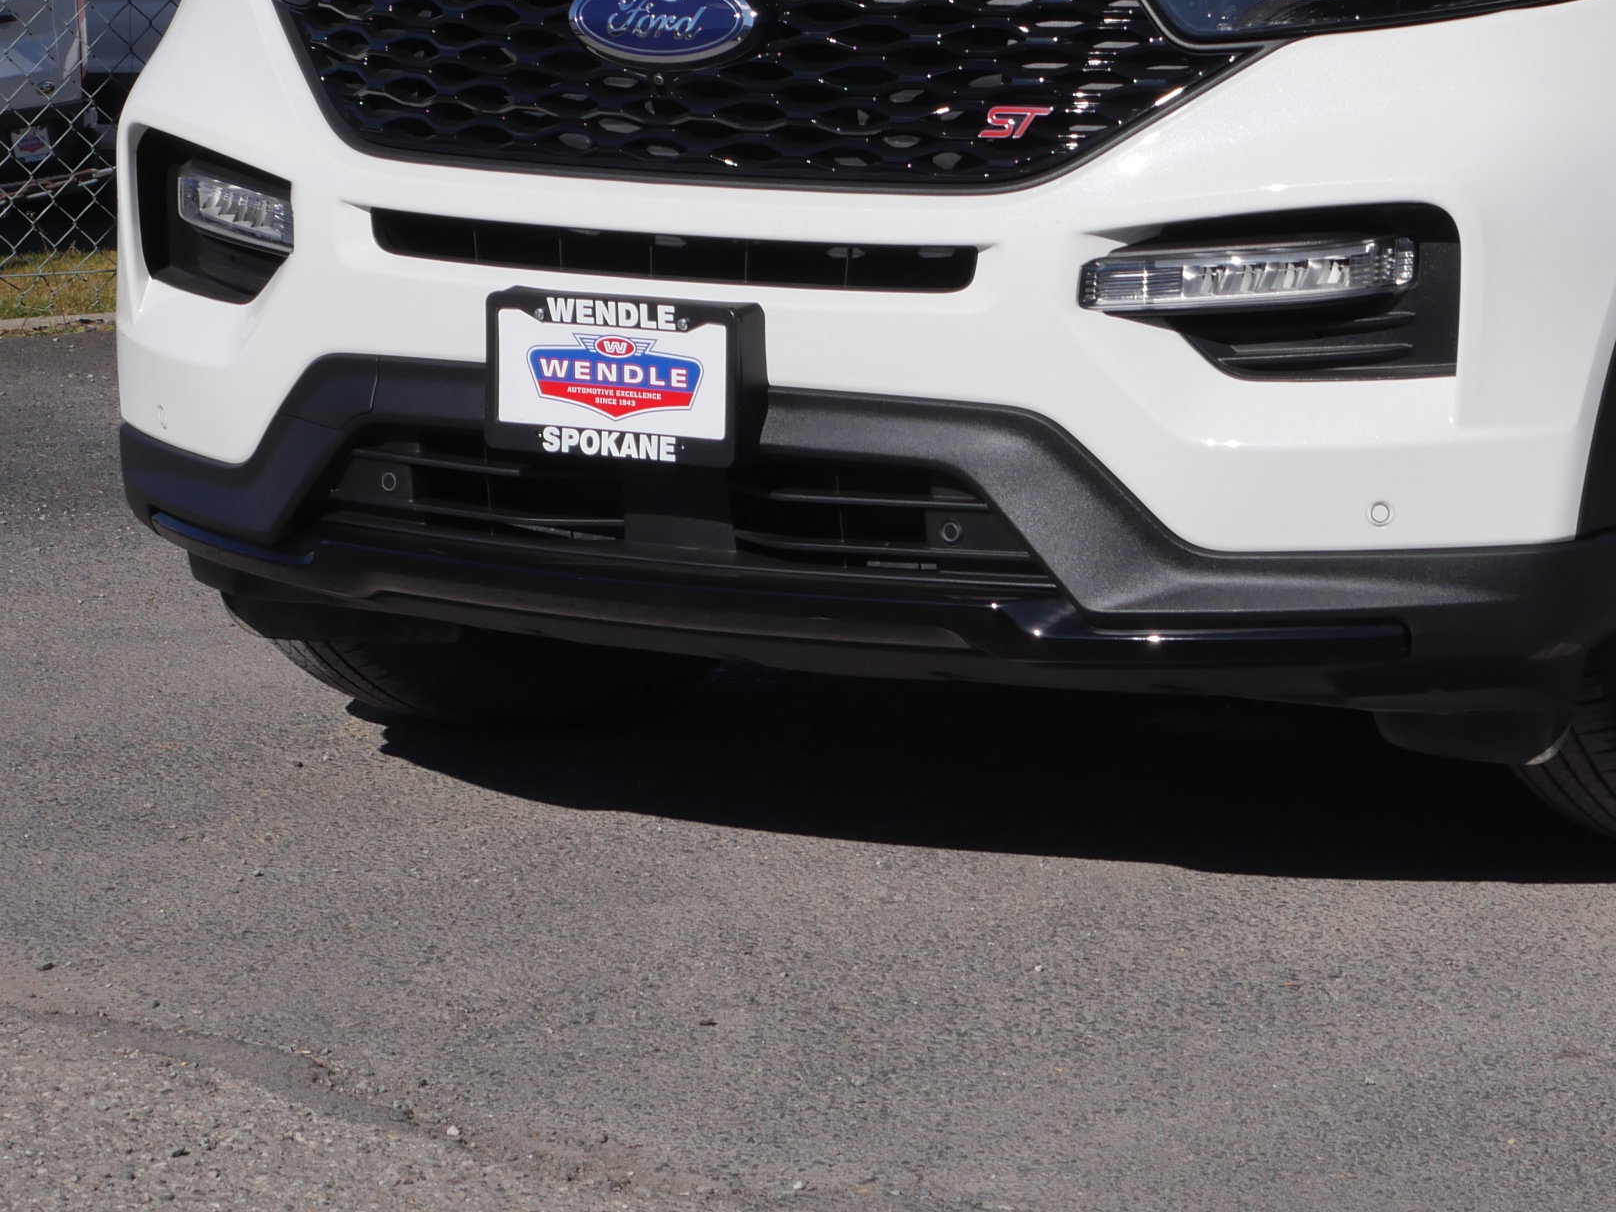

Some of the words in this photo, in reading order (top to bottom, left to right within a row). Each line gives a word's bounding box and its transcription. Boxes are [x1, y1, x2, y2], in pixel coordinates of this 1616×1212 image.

[978, 106, 1054, 138] ST
[546, 297, 677, 331] WENDLE
[539, 358, 688, 388] WENDLE
[567, 386, 614, 396] AUTOMOTIVE
[615, 389, 662, 400] EXCELLENCE
[595, 397, 617, 405] SINCE
[542, 426, 677, 462] SPOKANE
